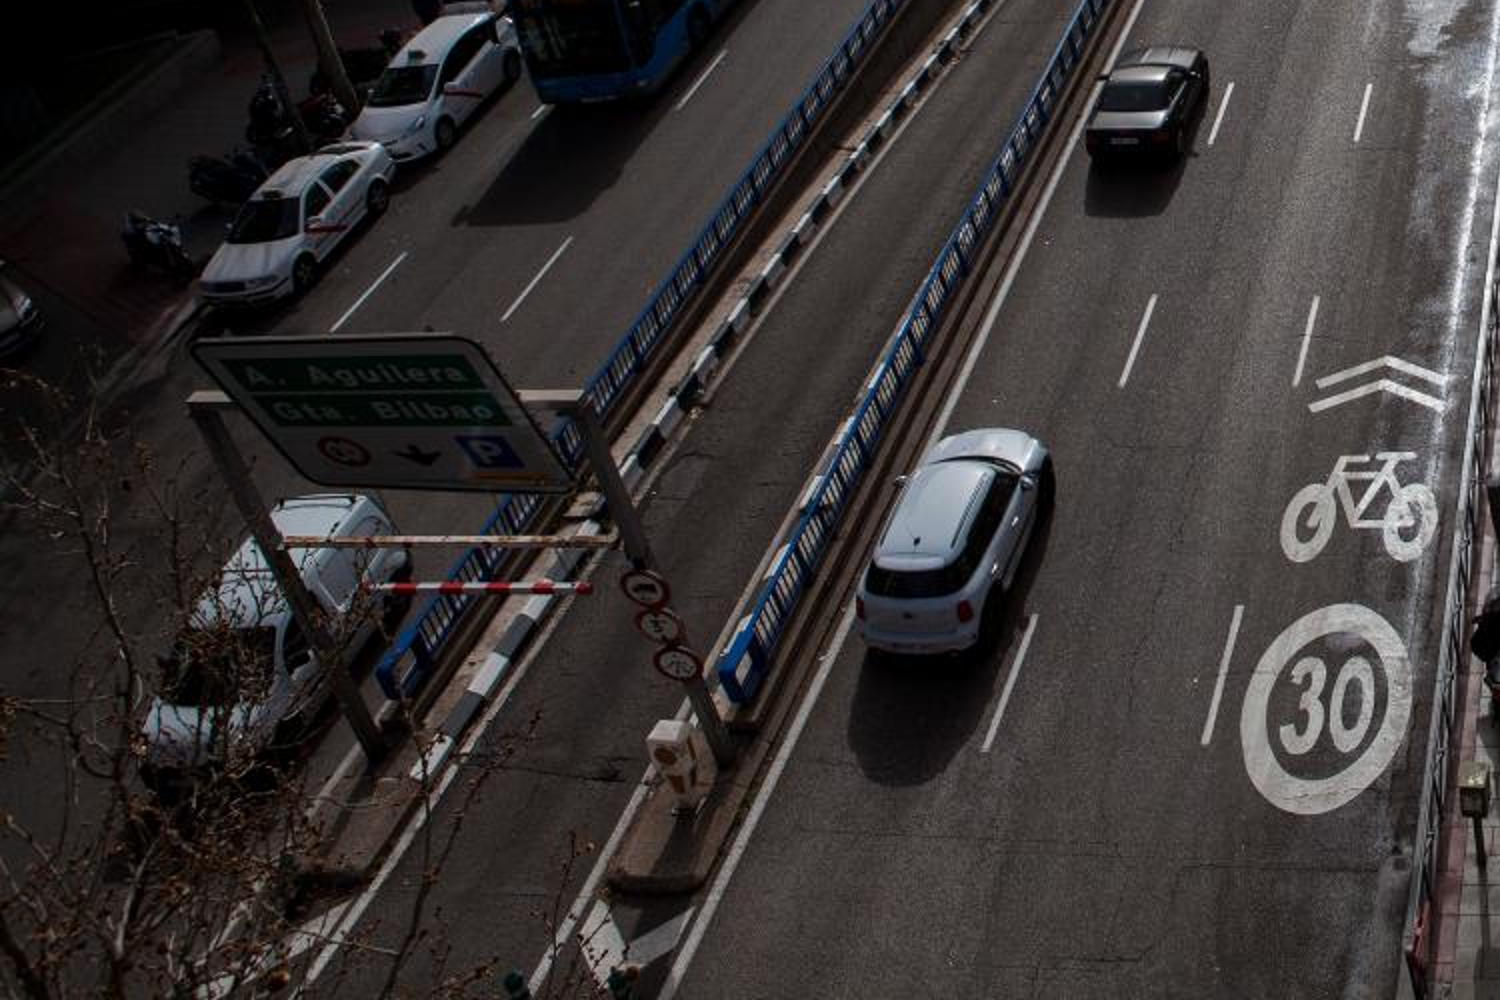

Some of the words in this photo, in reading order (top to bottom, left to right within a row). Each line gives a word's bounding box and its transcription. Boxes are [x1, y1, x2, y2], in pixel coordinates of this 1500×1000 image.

[244, 364, 287, 387] A.
[305, 362, 469, 388] Aguilera
[272, 401, 358, 422] Gta.
[368, 400, 495, 421] Bilbao
[466, 438, 502, 465] P
[1279, 655, 1376, 756] 30
